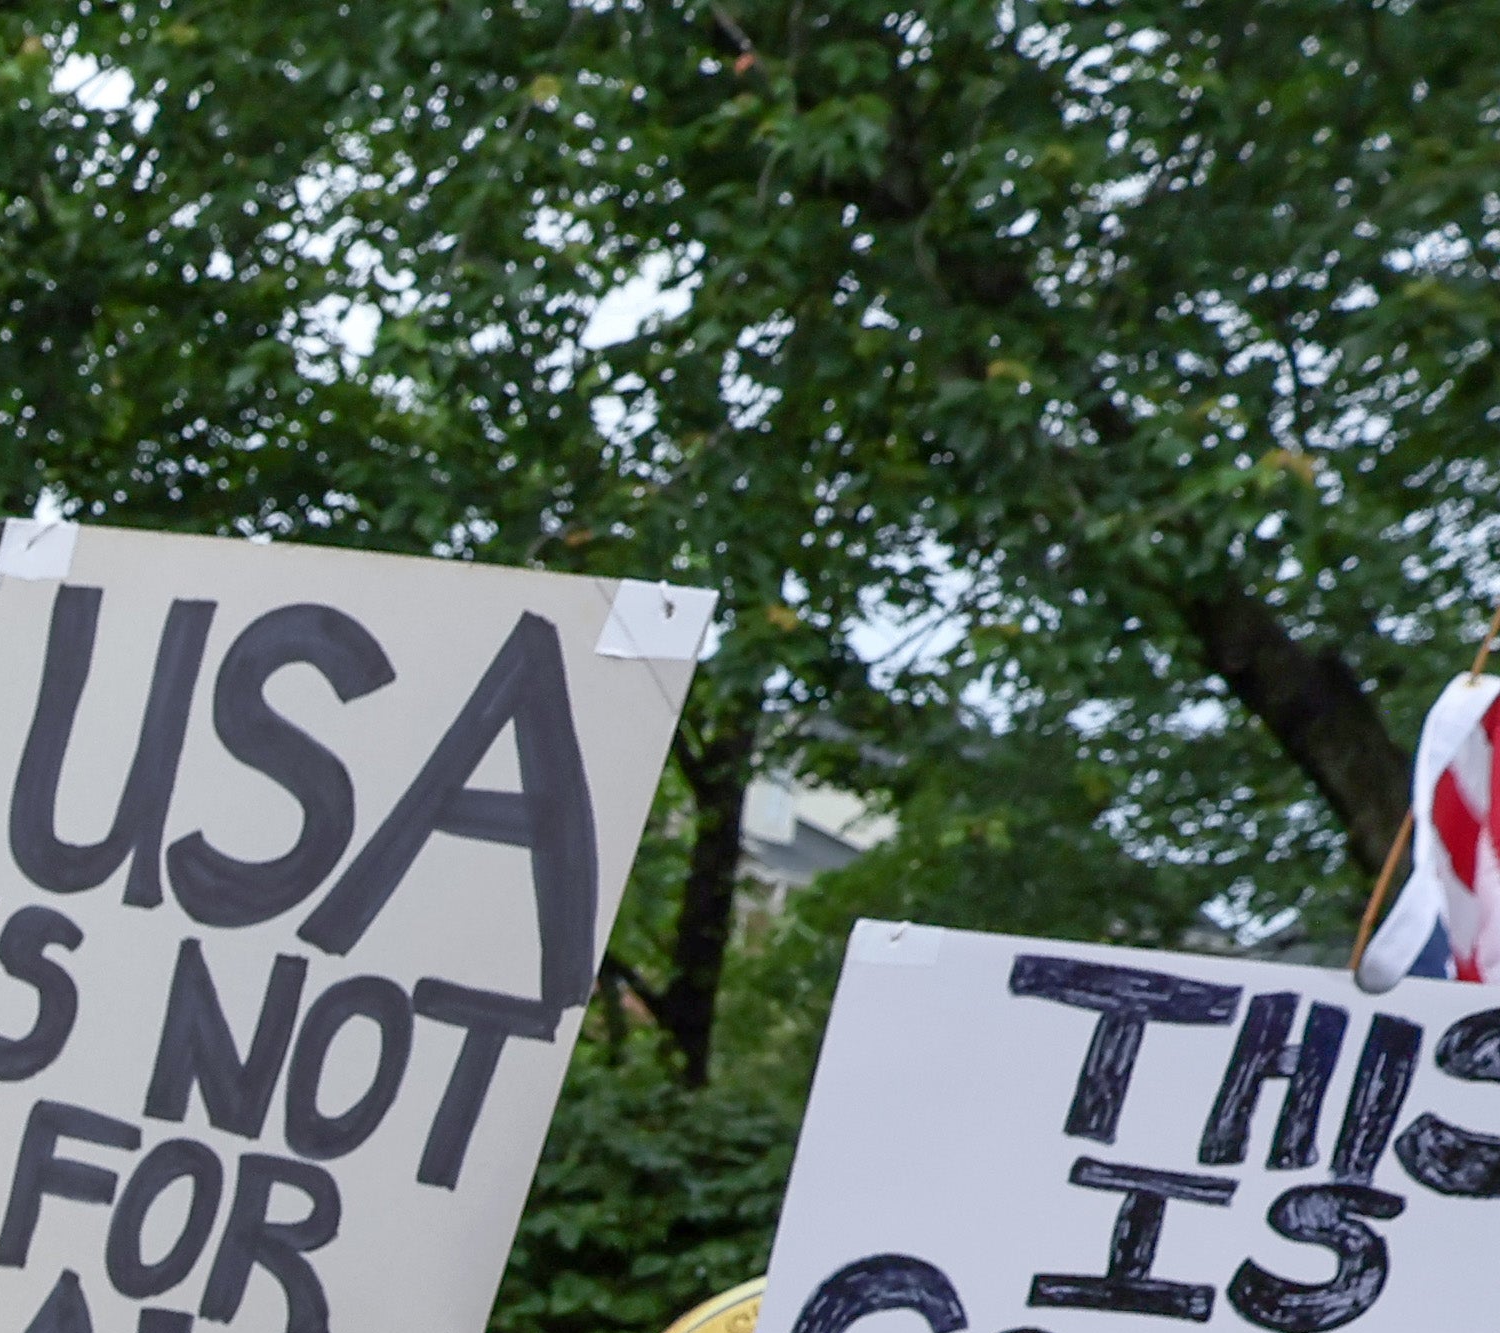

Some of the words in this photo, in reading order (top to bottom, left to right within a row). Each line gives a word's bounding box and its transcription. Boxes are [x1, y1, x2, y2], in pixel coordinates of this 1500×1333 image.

[9, 585, 598, 1003] USA
[144, 939, 563, 1189] NOT
[1026, 1156, 1406, 1333] IS
